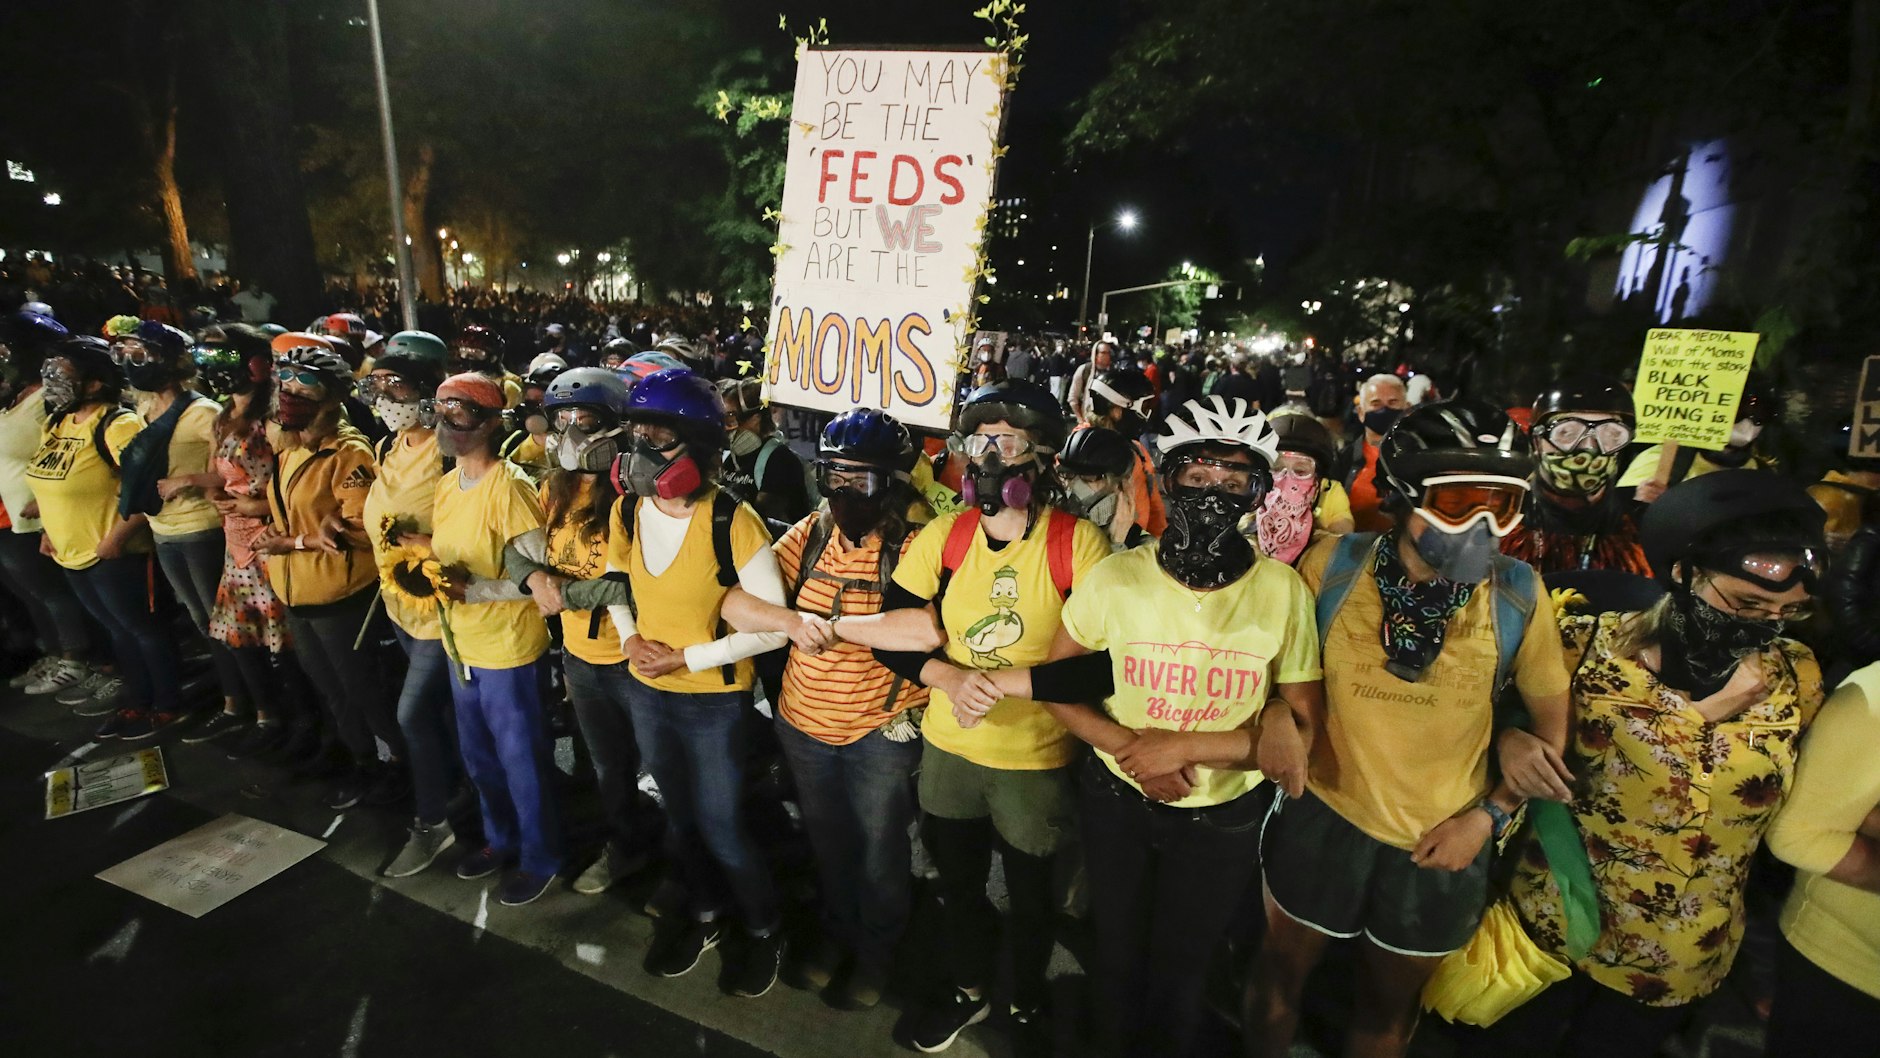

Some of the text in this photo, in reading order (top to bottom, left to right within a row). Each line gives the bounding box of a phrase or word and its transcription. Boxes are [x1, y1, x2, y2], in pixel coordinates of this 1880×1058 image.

[819, 51, 983, 104] YOU MAY
[820, 101, 944, 141] BE THE
[813, 204, 943, 254] BUT WE
[804, 242, 929, 288] ARE THE
[1649, 331, 1737, 344] DEAR MEDIA,
[1653, 344, 1746, 359] Wall of Moms
[1661, 358, 1686, 368] NOT
[1688, 359, 1712, 371] the
[1647, 370, 1709, 388] BLACK
[1655, 386, 1735, 407] PEOPLE
[1642, 404, 1703, 423] DYING
[342, 479, 372, 489] adida
[1124, 655, 1263, 700] RIVER CITY
[1350, 682, 1439, 707] Tillamook
[1146, 696, 1230, 732] Bicycles
